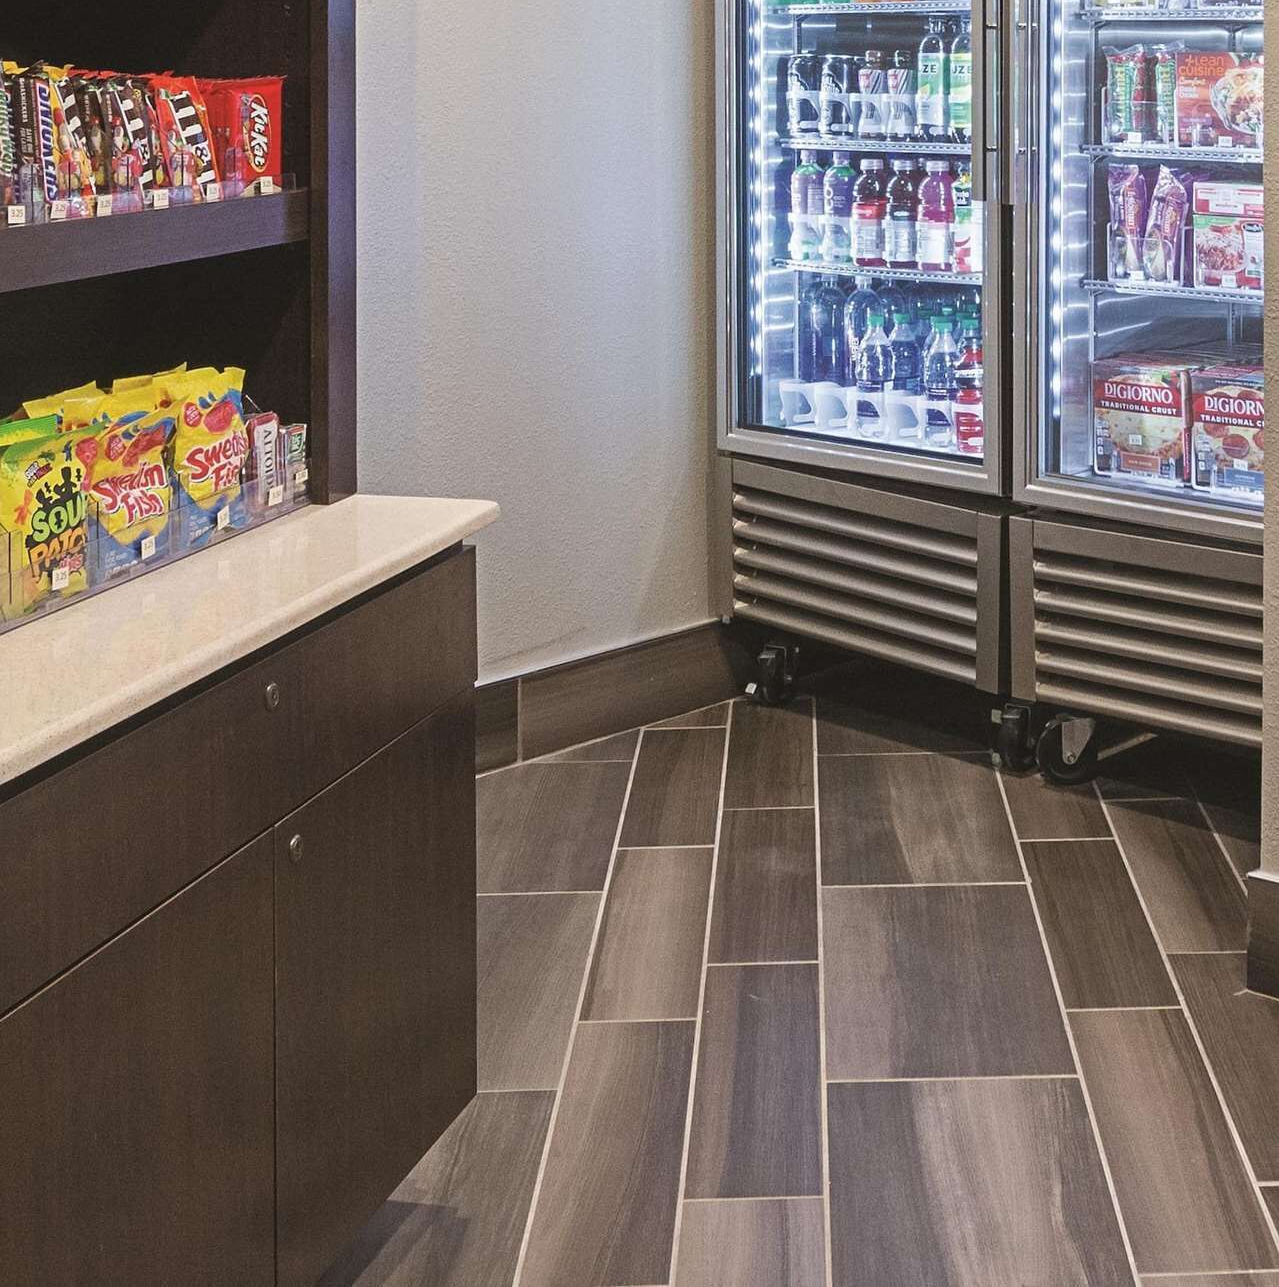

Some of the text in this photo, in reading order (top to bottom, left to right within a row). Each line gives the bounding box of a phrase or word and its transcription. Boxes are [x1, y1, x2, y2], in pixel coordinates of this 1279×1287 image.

[1101, 400, 1177, 415] TRADITIONAL CRUST
[1204, 396, 1264, 417] DIGIORN
[1200, 414, 1254, 427] TRADITIONAL
